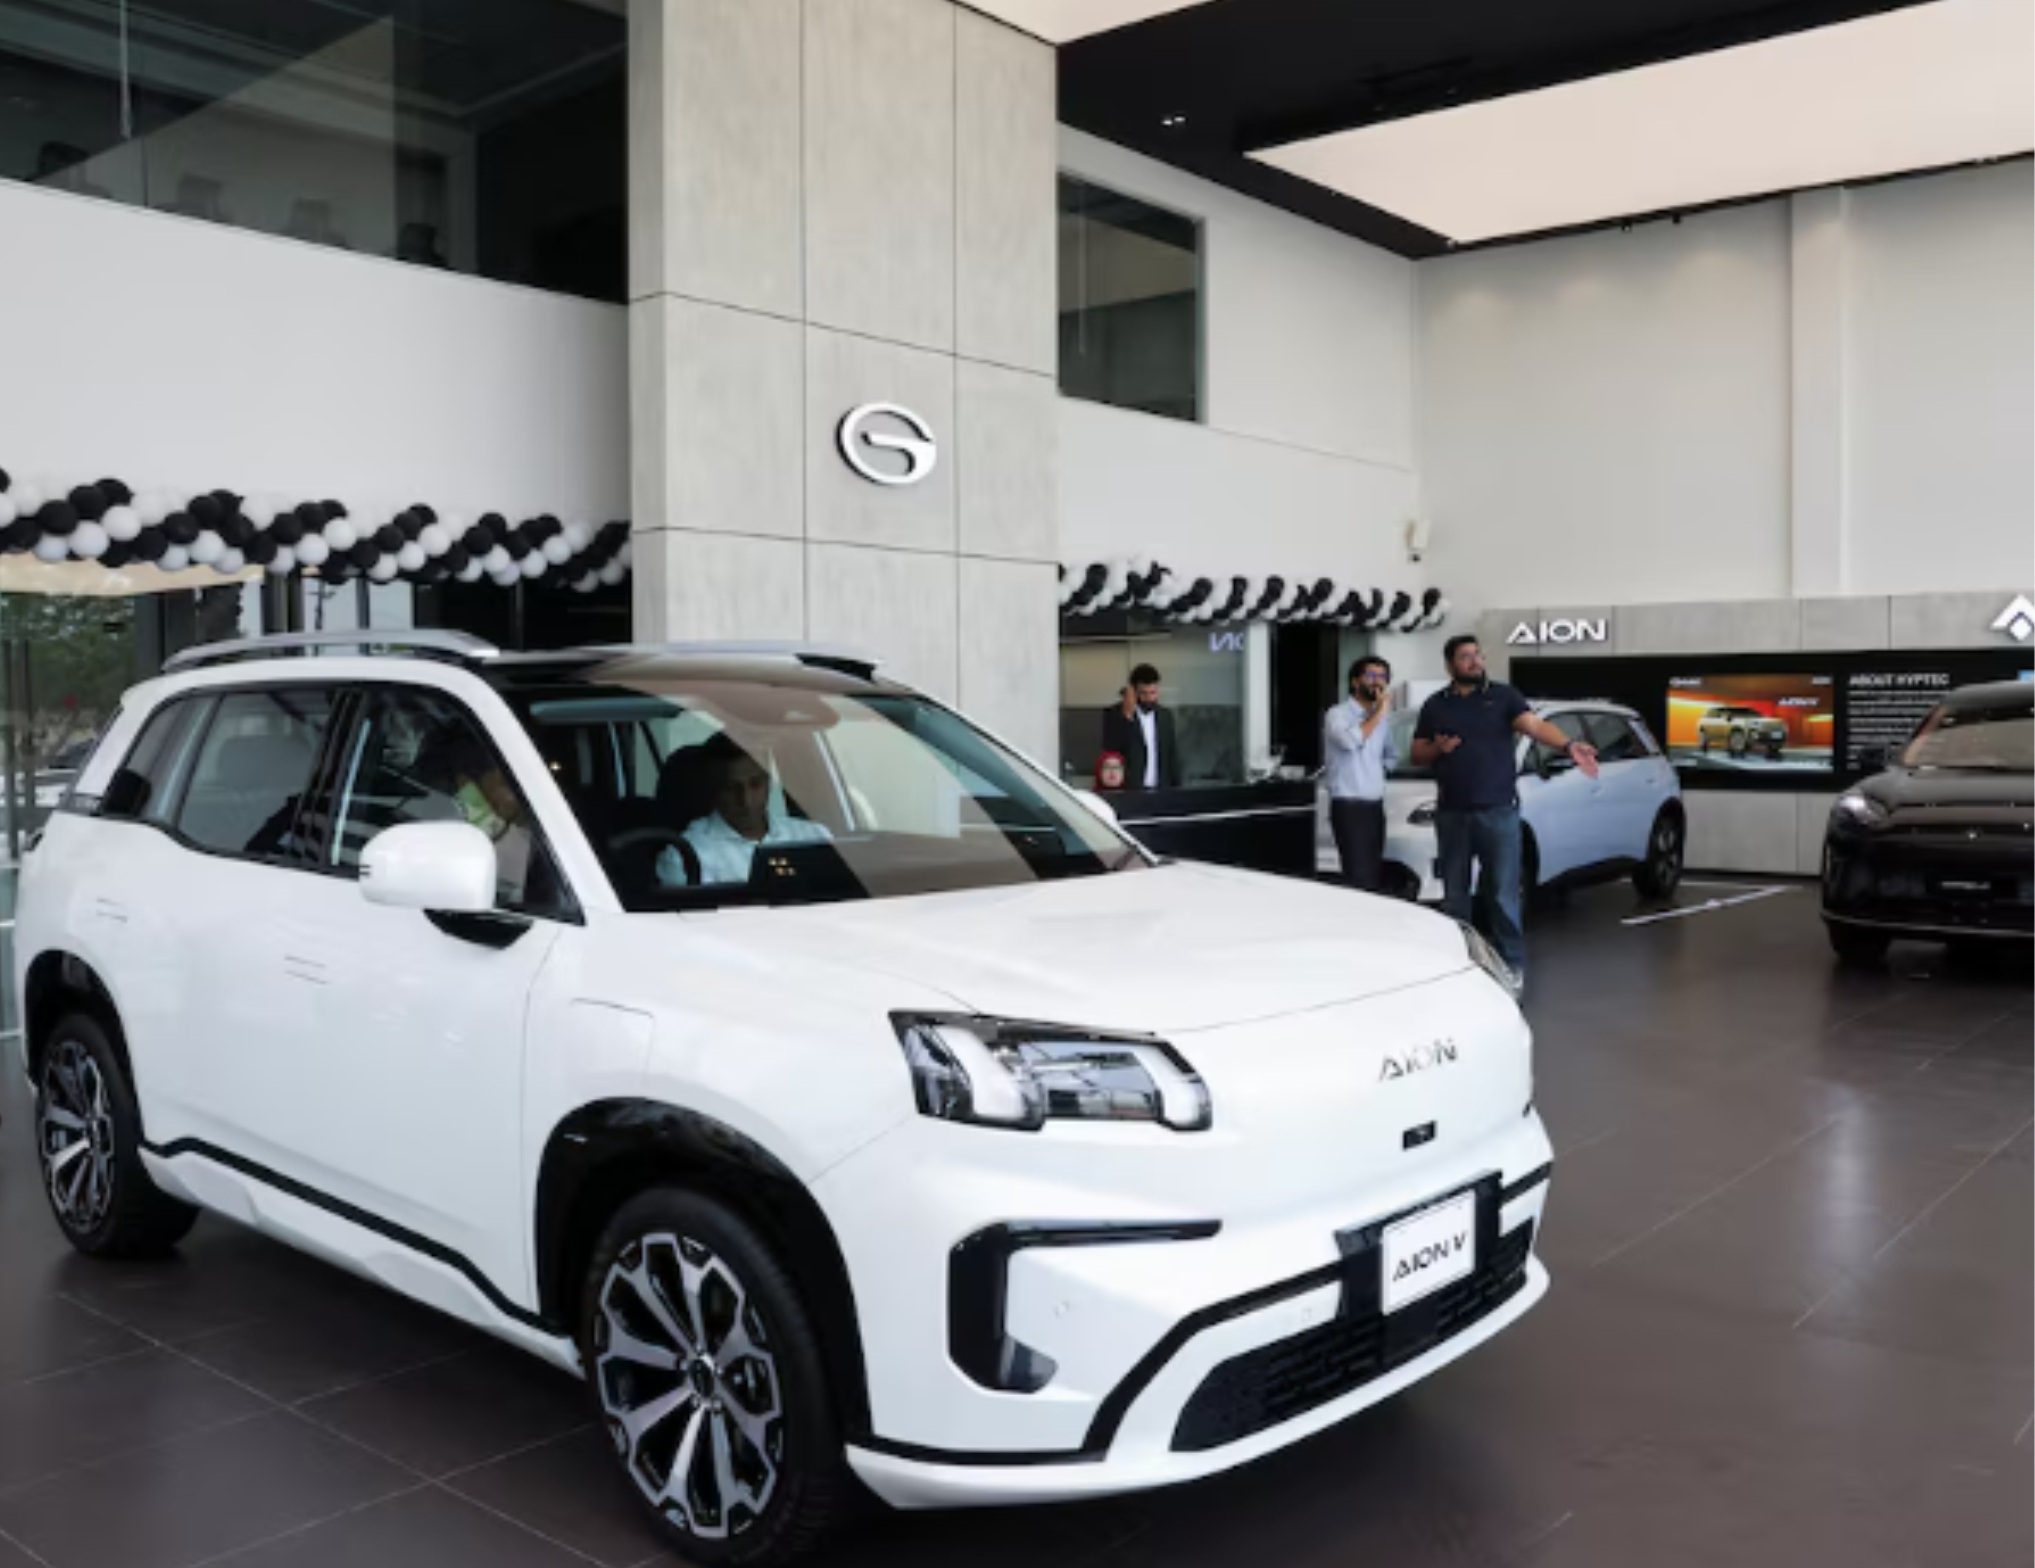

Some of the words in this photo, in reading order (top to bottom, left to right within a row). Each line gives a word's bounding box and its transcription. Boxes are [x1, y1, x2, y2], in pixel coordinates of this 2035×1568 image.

[1505, 618, 1607, 644] AION
[1378, 1037, 1459, 1082] AION
[1392, 1239, 1449, 1282] AION
[1453, 1231, 1467, 1251] V
